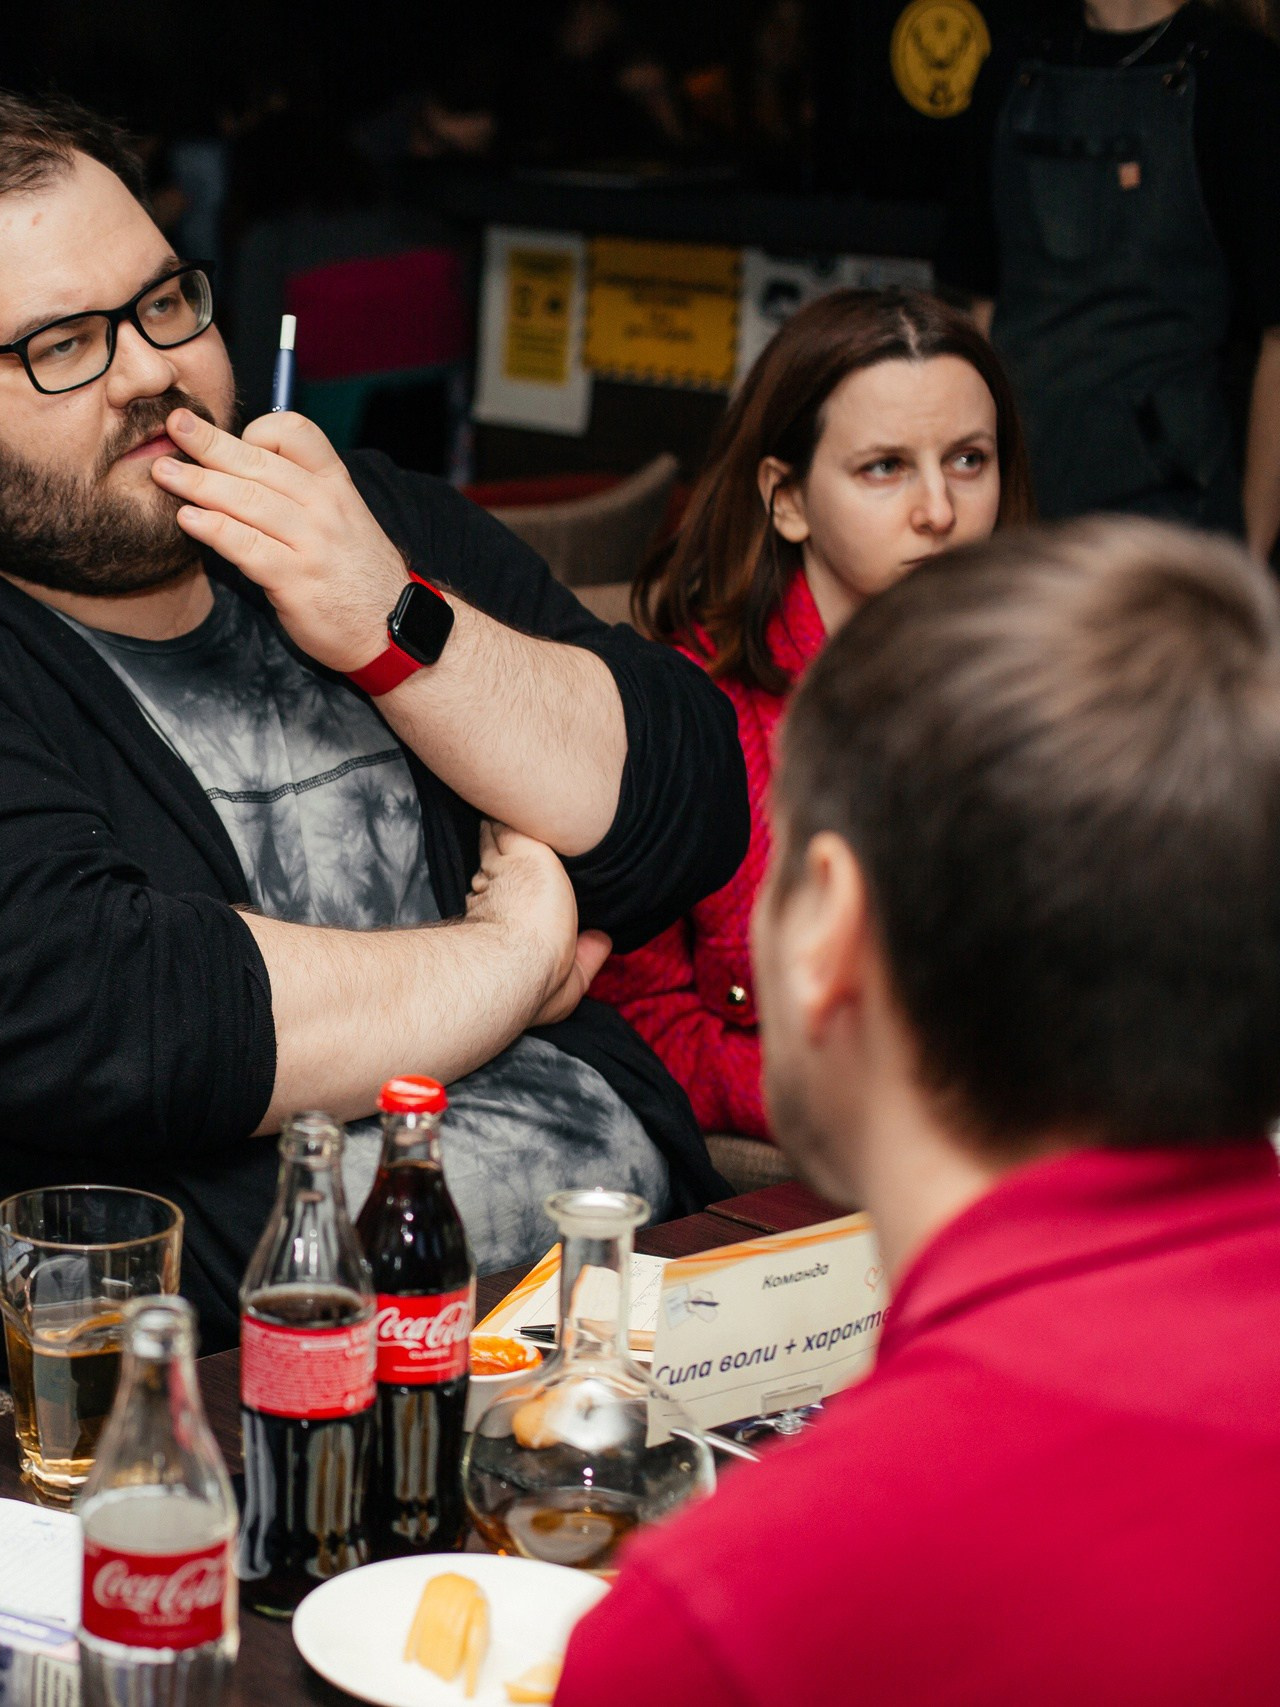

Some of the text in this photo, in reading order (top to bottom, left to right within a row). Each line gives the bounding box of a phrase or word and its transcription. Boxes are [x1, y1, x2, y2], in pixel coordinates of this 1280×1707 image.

[762, 1262, 830, 1290] Команда
[720, 1344, 777, 1373] воли
[784, 1338, 798, 1354] +
